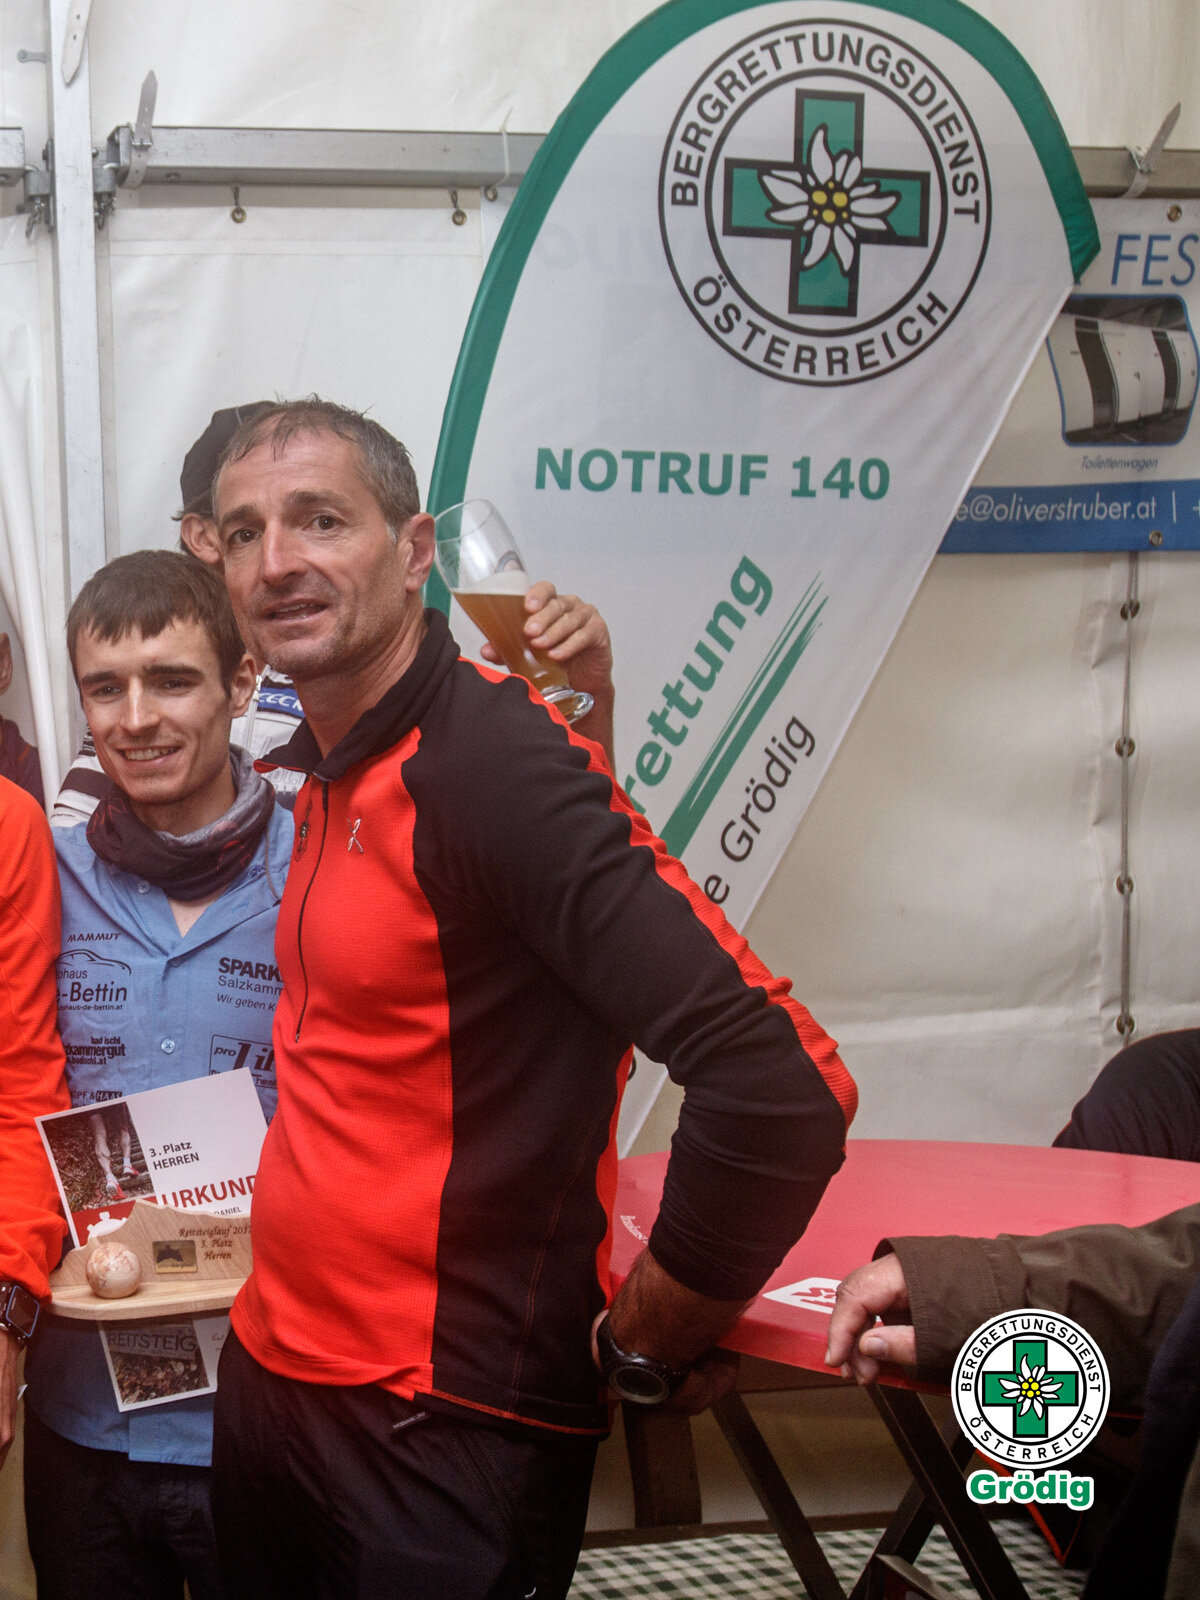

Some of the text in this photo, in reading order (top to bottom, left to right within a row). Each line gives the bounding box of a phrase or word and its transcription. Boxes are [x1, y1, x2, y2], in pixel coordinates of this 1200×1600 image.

[671, 32, 981, 223] BERGRETTUNGSDIENST
[693, 273, 951, 377] ÖSTERREICH
[1081, 455, 1159, 472] Toilettenwagen
[535, 447, 891, 500] NOTRUF 140
[720, 716, 816, 863] Grödig
[67, 932, 121, 942] MAMMUT
[218, 957, 283, 982] SPARK
[217, 993, 233, 1003] Wir
[235, 998, 266, 1010] geben
[214, 1047, 237, 1057] pro
[163, 1142, 193, 1155] Platz
[153, 1152, 200, 1170] HERREN
[179, 1226, 230, 1238] Reitsteiglauf
[212, 1239, 234, 1248] Platz
[204, 1251, 232, 1261] Herren
